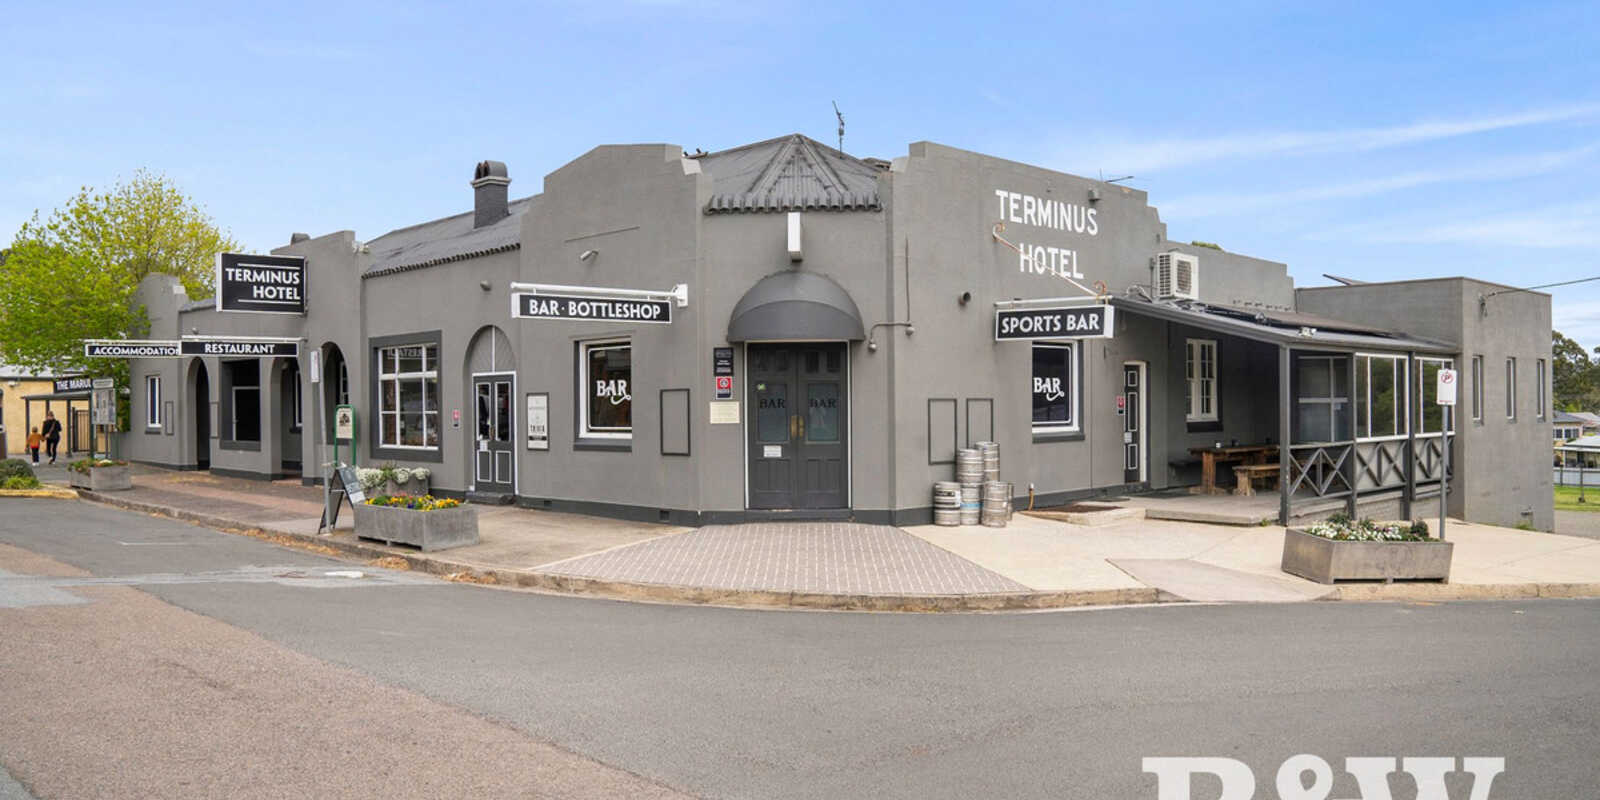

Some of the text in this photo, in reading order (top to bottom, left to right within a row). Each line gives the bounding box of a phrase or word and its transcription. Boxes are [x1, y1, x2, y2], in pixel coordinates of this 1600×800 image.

[996, 189, 1098, 236] TERMINUS
[1020, 243, 1084, 279] HOTEL
[225, 268, 300, 284] TERMINUS
[253, 285, 300, 300] HOTEL
[529, 299, 661, 319] BAR BOTTLESHOP
[1002, 313, 1100, 334] SPORTS BAR
[204, 344, 275, 354] RESTAURANT
[596, 380, 631, 405] BAR
[1033, 377, 1064, 401] BAR
[759, 398, 786, 409] BAR
[809, 398, 837, 409] BAR
